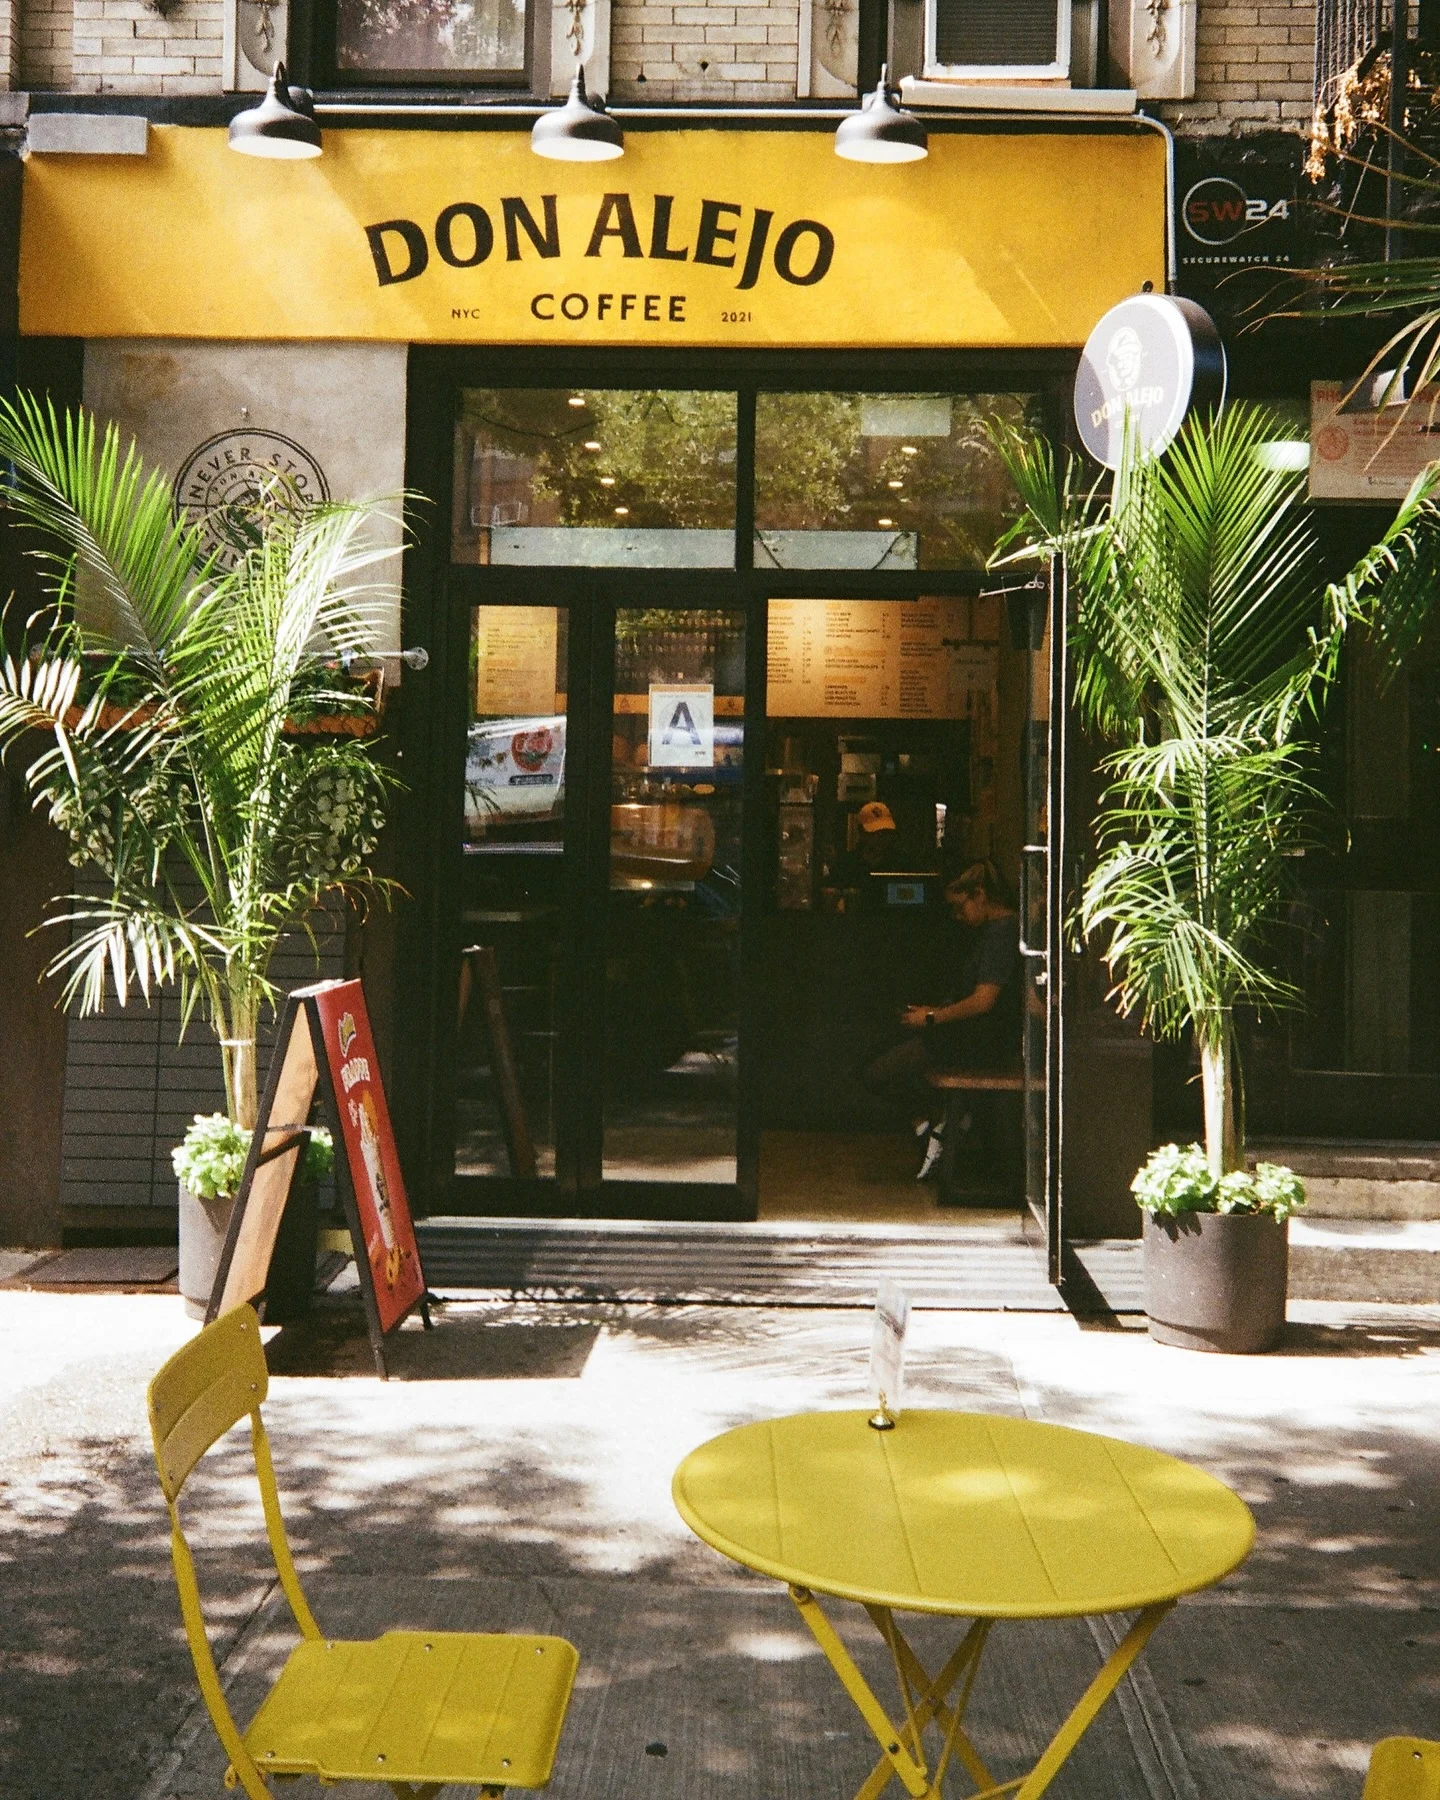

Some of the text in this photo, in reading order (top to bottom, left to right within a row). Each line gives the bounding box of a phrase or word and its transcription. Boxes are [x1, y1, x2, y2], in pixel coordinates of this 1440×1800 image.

[364, 193, 835, 290] DON ALEJO
[1182, 255, 1269, 264] SECUREWATCH
[451, 308, 481, 320] NYC
[530, 293, 687, 322] COFFEE
[721, 311, 753, 323] 2021
[1091, 395, 1122, 429] DON
[189, 447, 251, 500] NEVER
[269, 453, 315, 506] STOP
[661, 701, 702, 745] A
